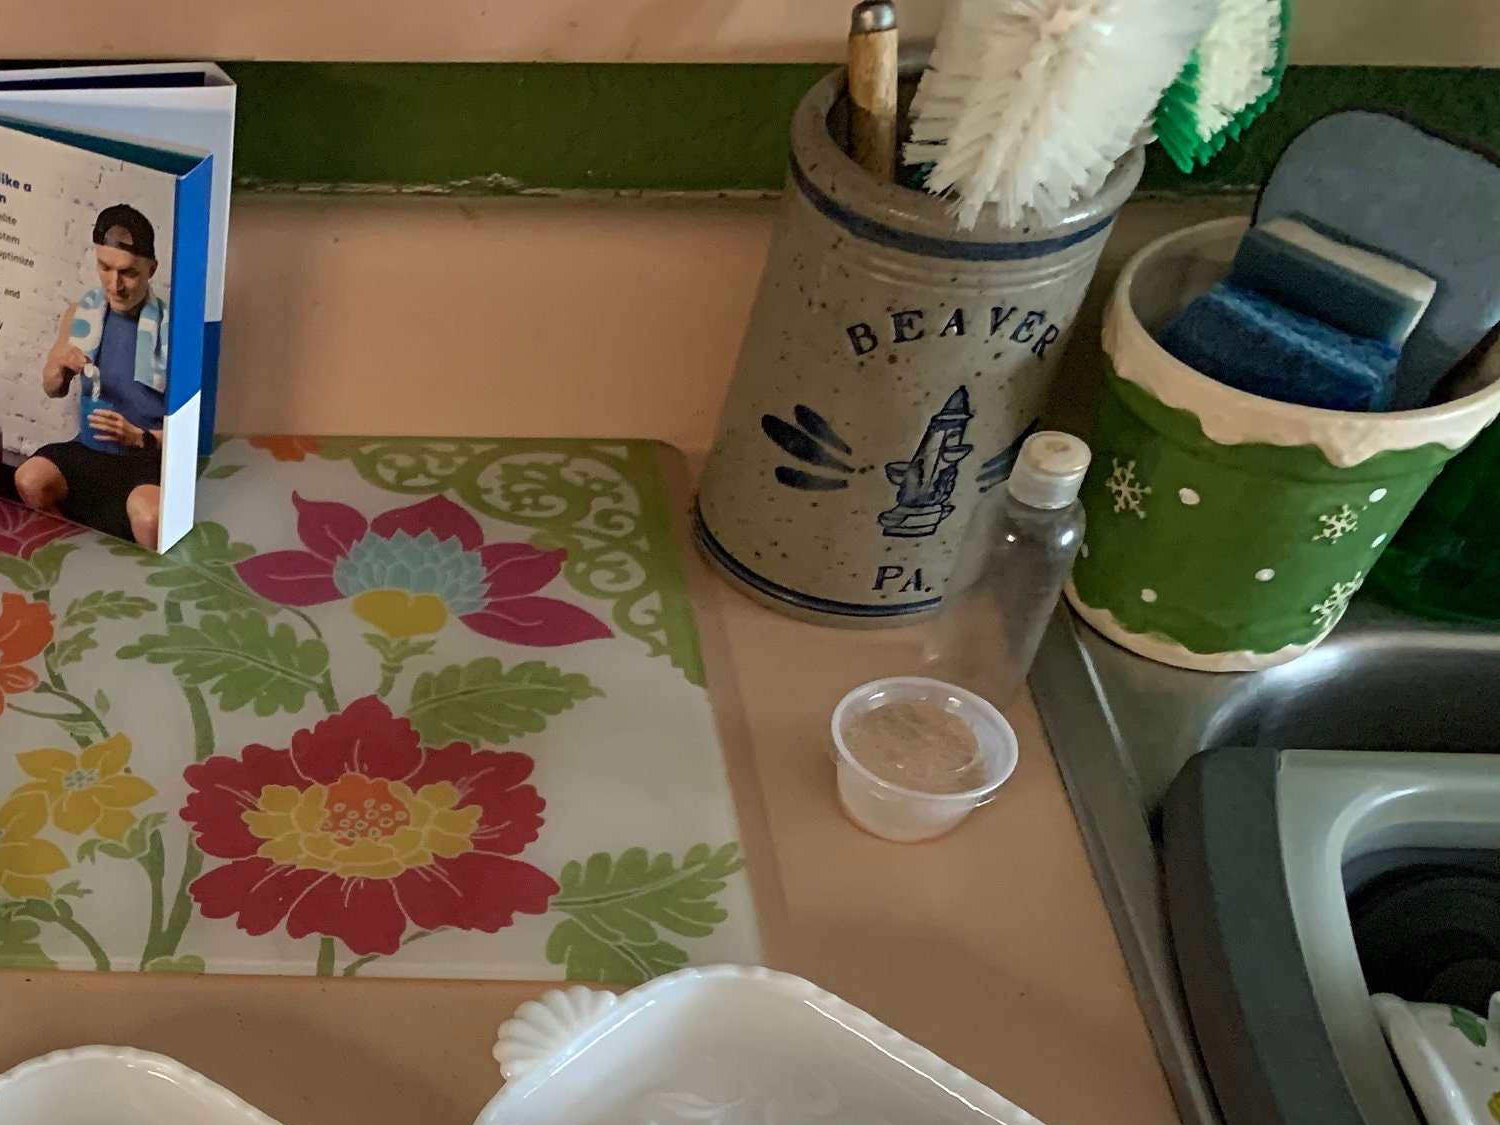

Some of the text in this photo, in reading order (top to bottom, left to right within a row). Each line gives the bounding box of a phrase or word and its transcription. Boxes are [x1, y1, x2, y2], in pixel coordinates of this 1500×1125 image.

[23, 183, 32, 192] a
[4, 287, 21, 299] and
[846, 306, 1060, 359] BEAVER
[872, 566, 931, 592] PA.
